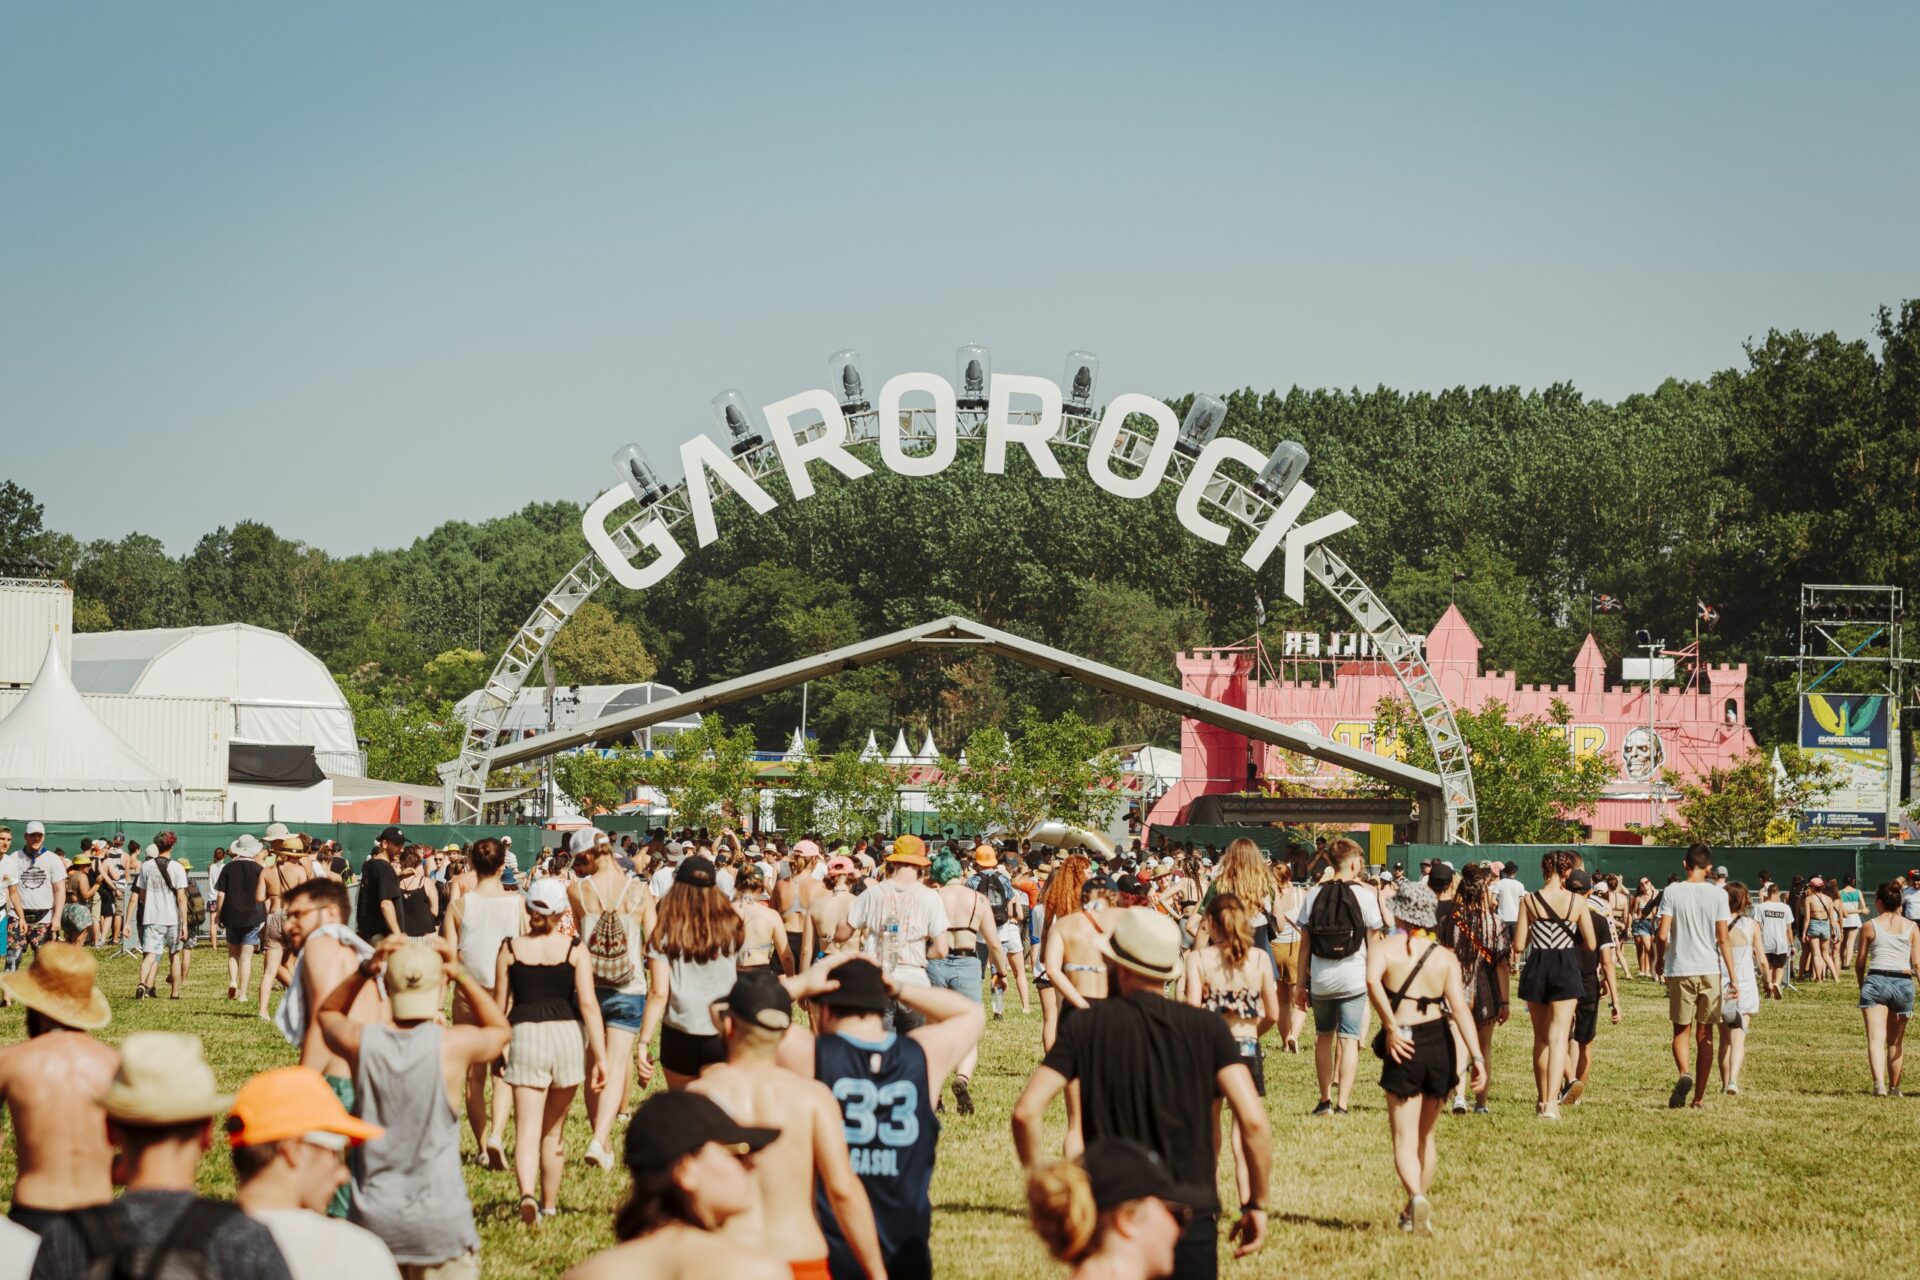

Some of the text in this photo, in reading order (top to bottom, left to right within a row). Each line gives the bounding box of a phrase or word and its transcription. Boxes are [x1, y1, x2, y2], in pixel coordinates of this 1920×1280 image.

[583, 372, 1359, 606] GAROROCK
[833, 1077, 919, 1146] 33
[850, 1148, 899, 1176] GASOL
